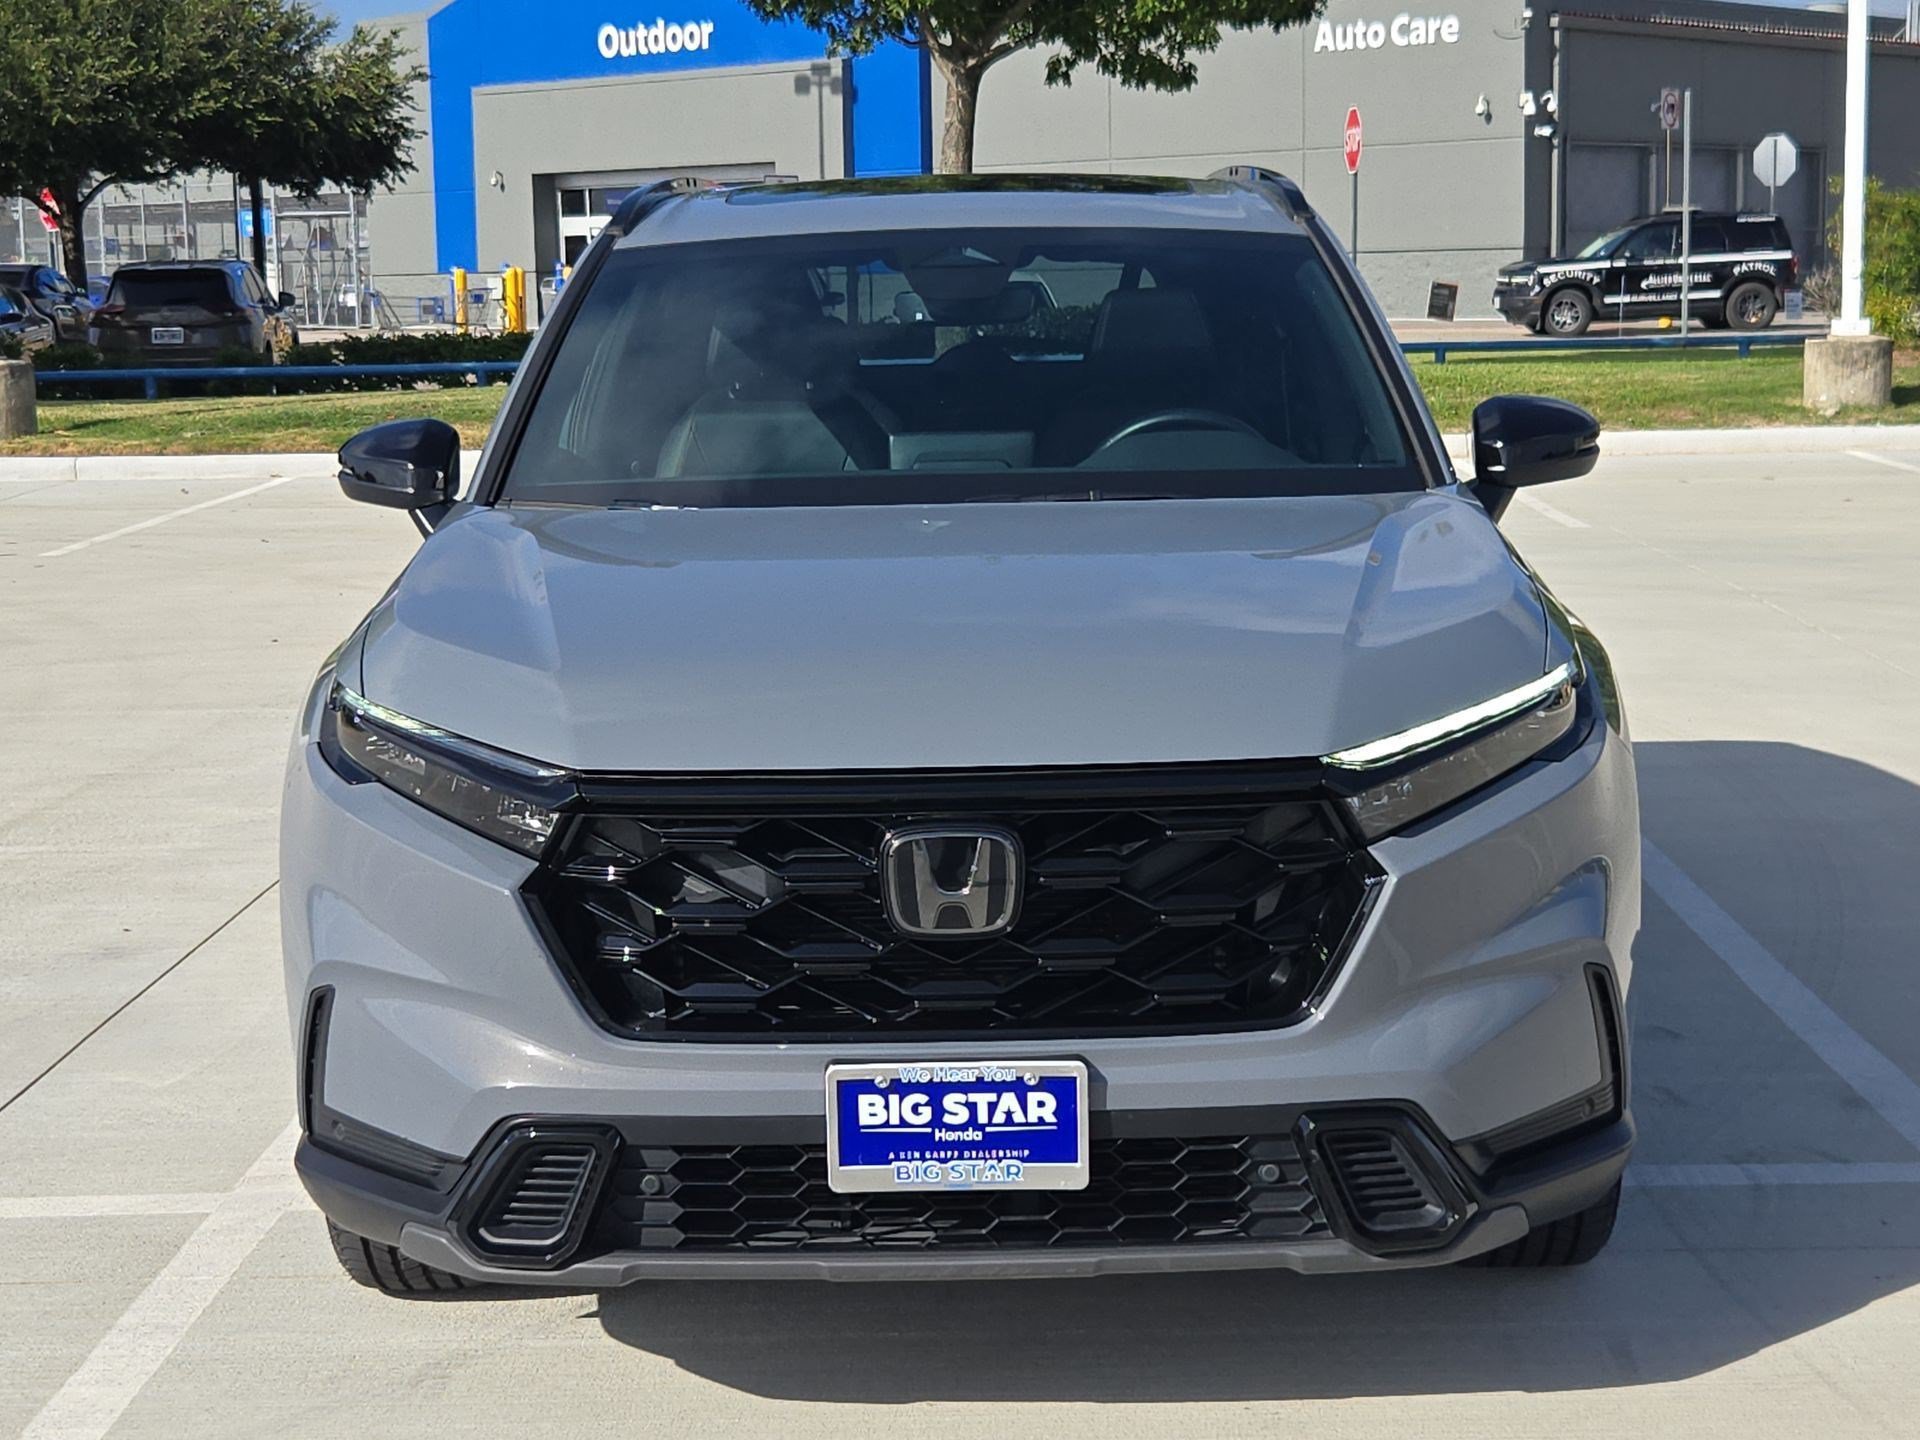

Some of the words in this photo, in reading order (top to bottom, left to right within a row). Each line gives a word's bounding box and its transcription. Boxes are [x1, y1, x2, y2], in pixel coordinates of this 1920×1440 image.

[597, 16, 714, 59] Outdoor
[1314, 19, 1386, 53] Auto
[1390, 12, 1460, 47] Care
[1346, 128, 1361, 152] STOP
[1543, 268, 1601, 288] SECURITY
[1732, 262, 1776, 277] PATROL
[899, 1067, 930, 1083] We
[932, 1067, 979, 1082] Hear
[980, 1066, 1017, 1082] You
[857, 1093, 933, 1126] BIG
[942, 1091, 1058, 1125] STAR
[934, 1127, 983, 1142] Honda
[888, 1152, 895, 1160] A
[963, 1149, 1030, 1159] DEALERSHIP
[894, 1162, 942, 1183] BIG
[948, 1160, 1024, 1182] STAR
